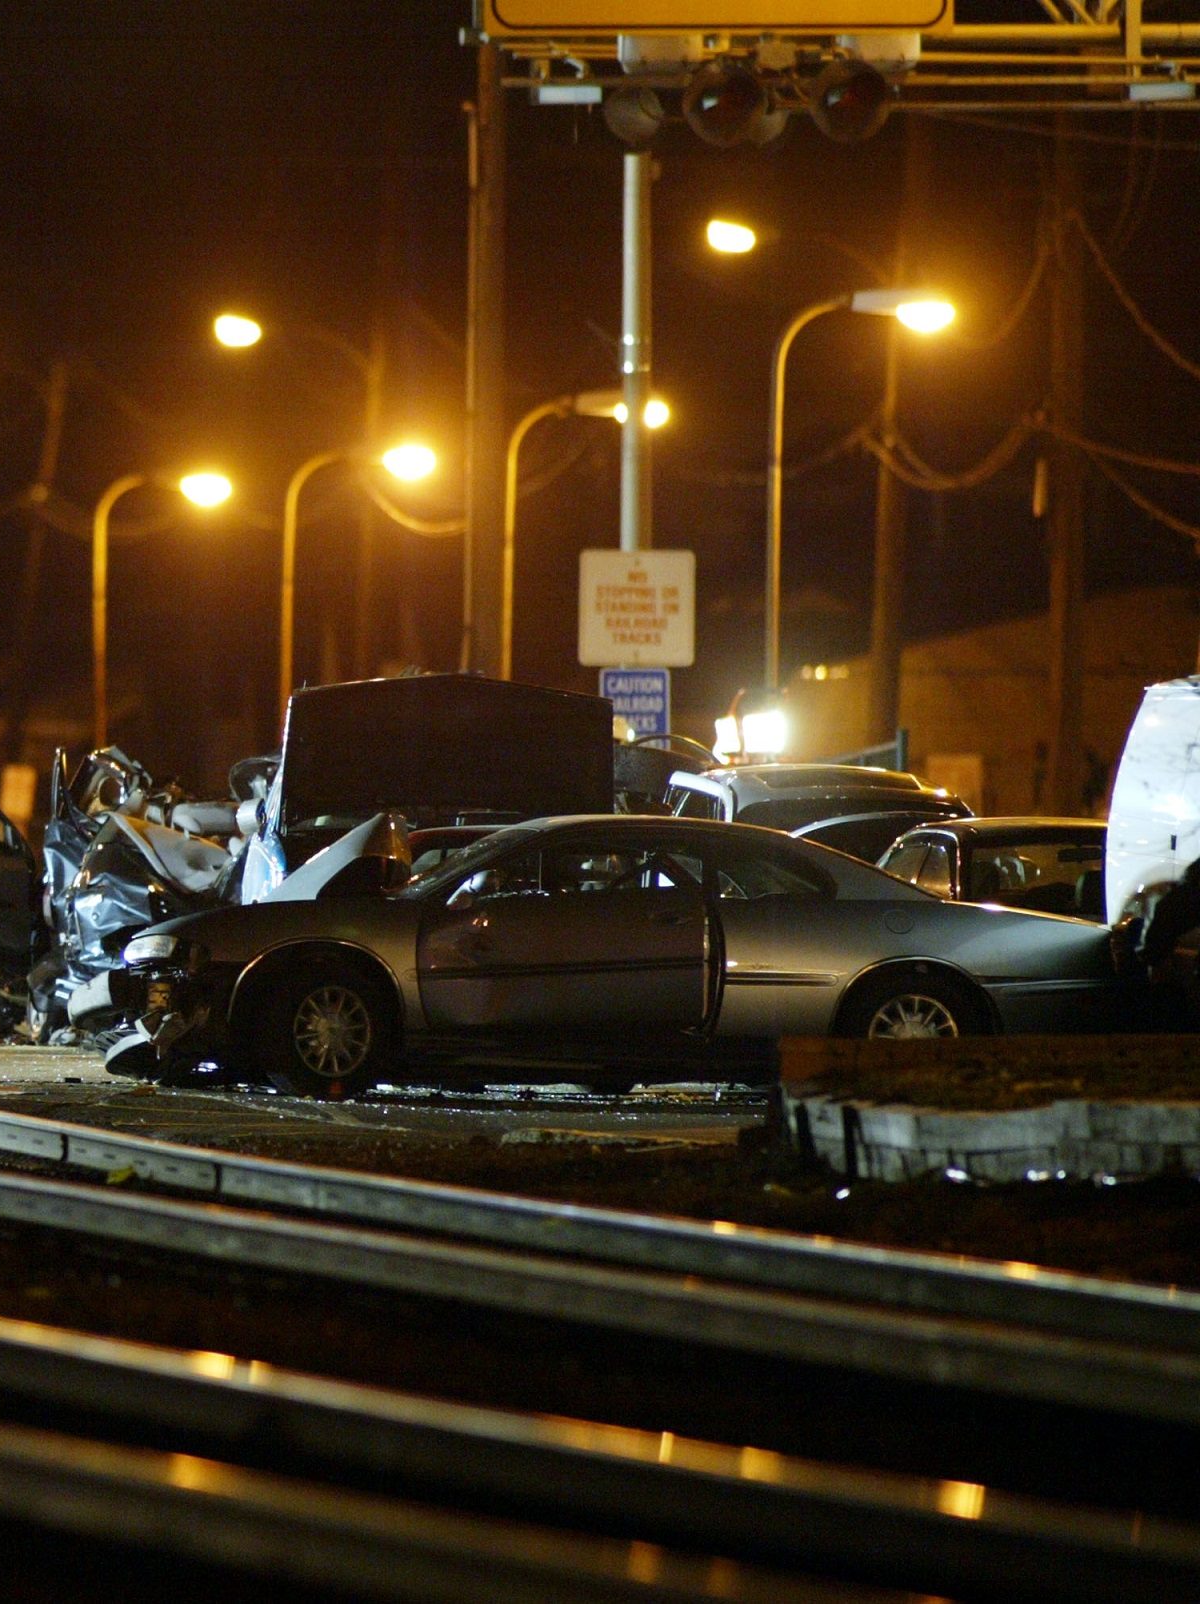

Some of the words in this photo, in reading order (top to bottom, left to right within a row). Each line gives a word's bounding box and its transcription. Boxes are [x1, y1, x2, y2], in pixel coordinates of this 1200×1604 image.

[628, 571, 648, 583] NO
[605, 617, 668, 629] RAILROAD
[612, 633, 661, 645] TRACKS
[607, 677, 663, 694] CAUTION
[611, 696, 663, 713] AILROAD
